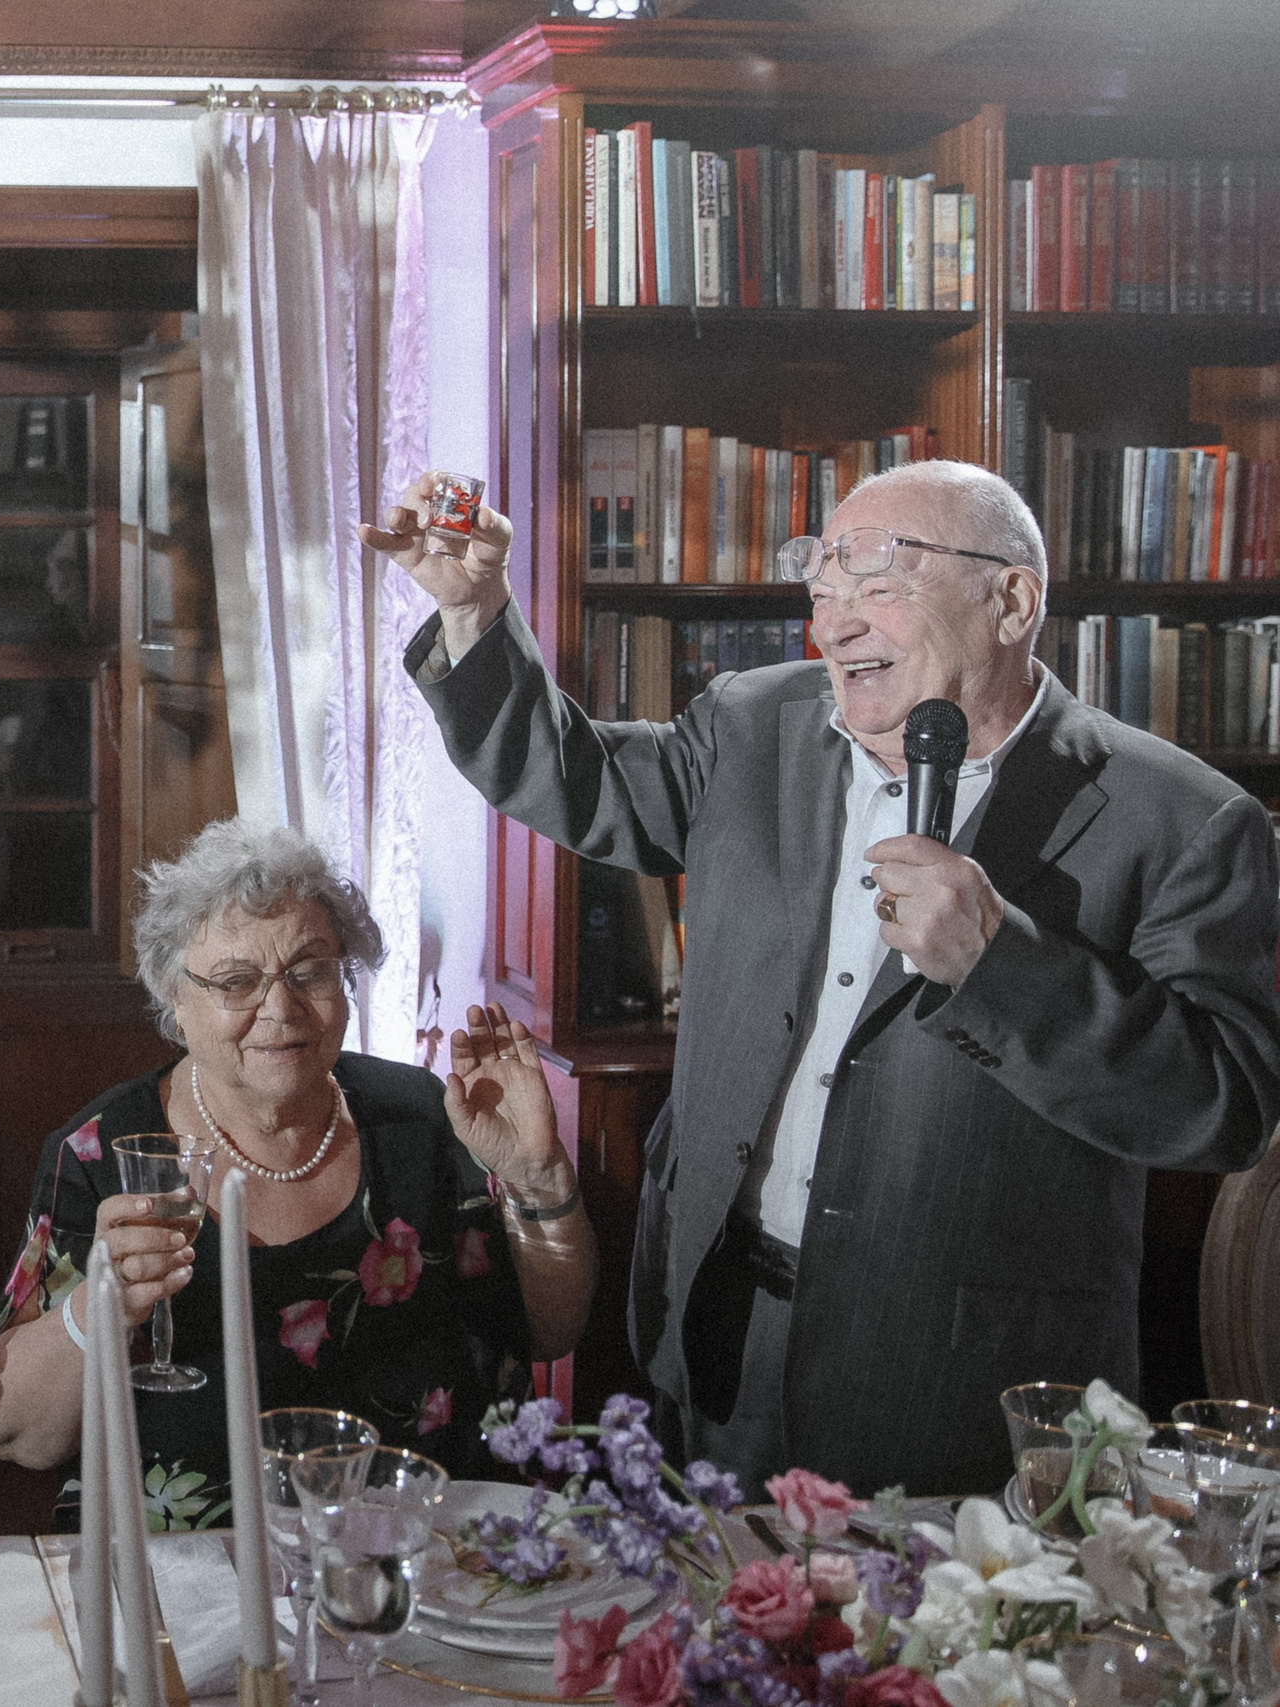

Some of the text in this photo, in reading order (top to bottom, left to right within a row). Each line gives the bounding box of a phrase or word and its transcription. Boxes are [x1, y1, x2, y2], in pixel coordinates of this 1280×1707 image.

[585, 138, 595, 230] VOIR LA FRANCE
[697, 155, 706, 219] DAYAN
[705, 155, 716, 219] MOSHE
